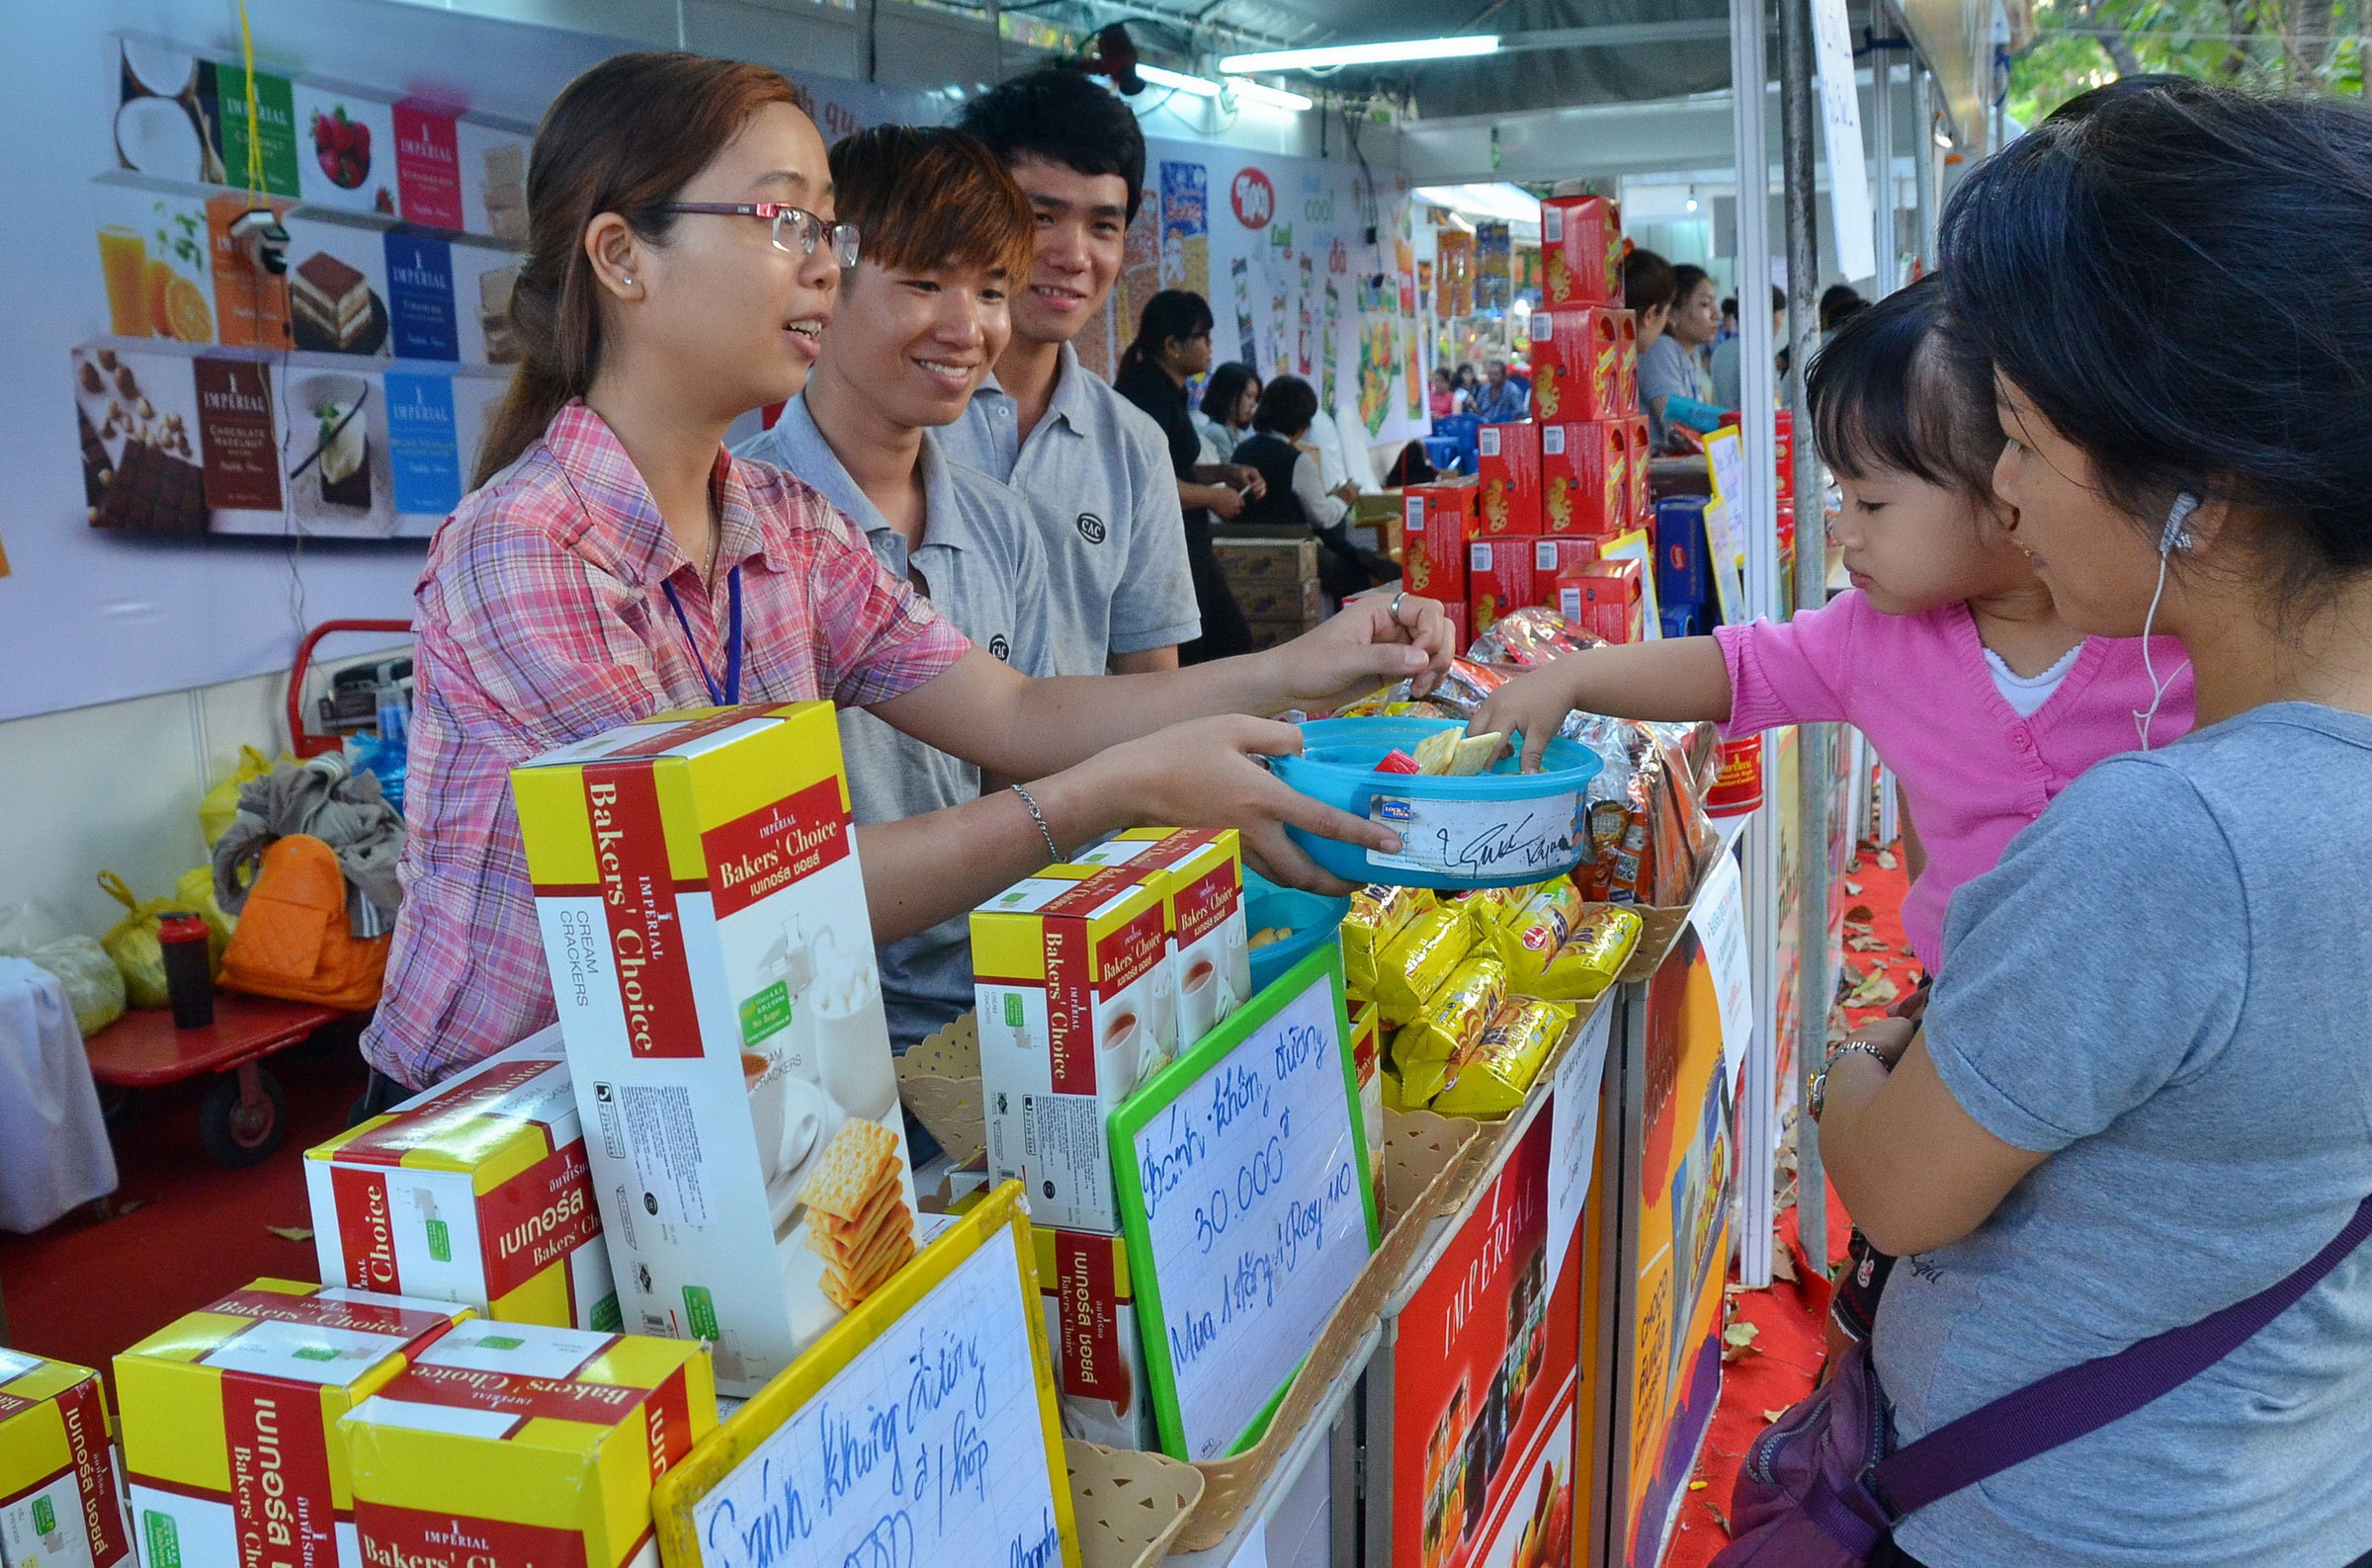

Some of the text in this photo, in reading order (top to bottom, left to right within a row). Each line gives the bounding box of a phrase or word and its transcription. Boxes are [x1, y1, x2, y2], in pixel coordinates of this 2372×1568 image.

[204, 390, 266, 414] IMPERIAL
[720, 819, 838, 889] Bakers' Choice
[759, 813, 797, 840] IMPERIAL
[588, 780, 653, 1053] Bakers' Choice
[637, 874, 664, 961] IMPERIAL
[1181, 884, 1234, 932] Bakers' Choice
[558, 909, 589, 1008] CRACKERS
[576, 909, 600, 974] CREAM
[1103, 932, 1162, 982] Bakers' Choice
[1046, 931, 1069, 1081] Bakers' Choice
[1069, 986, 1080, 1031] IMPERIAL
[364, 1185, 393, 1283] Choice
[533, 1222, 579, 1268] Bakers'
[1444, 1177, 1535, 1360] IMPERIAL
[213, 1299, 409, 1337] Bakers' Choice
[1060, 1275, 1076, 1358] Bakers' Choice
[1170, 1311, 1218, 1376] Mua
[410, 1365, 630, 1406] Bakers' Choice
[471, 1390, 532, 1406] IMPERIAL
[233, 1445, 260, 1527] Bakers'
[424, 1529, 490, 1551] IMPERIAL
